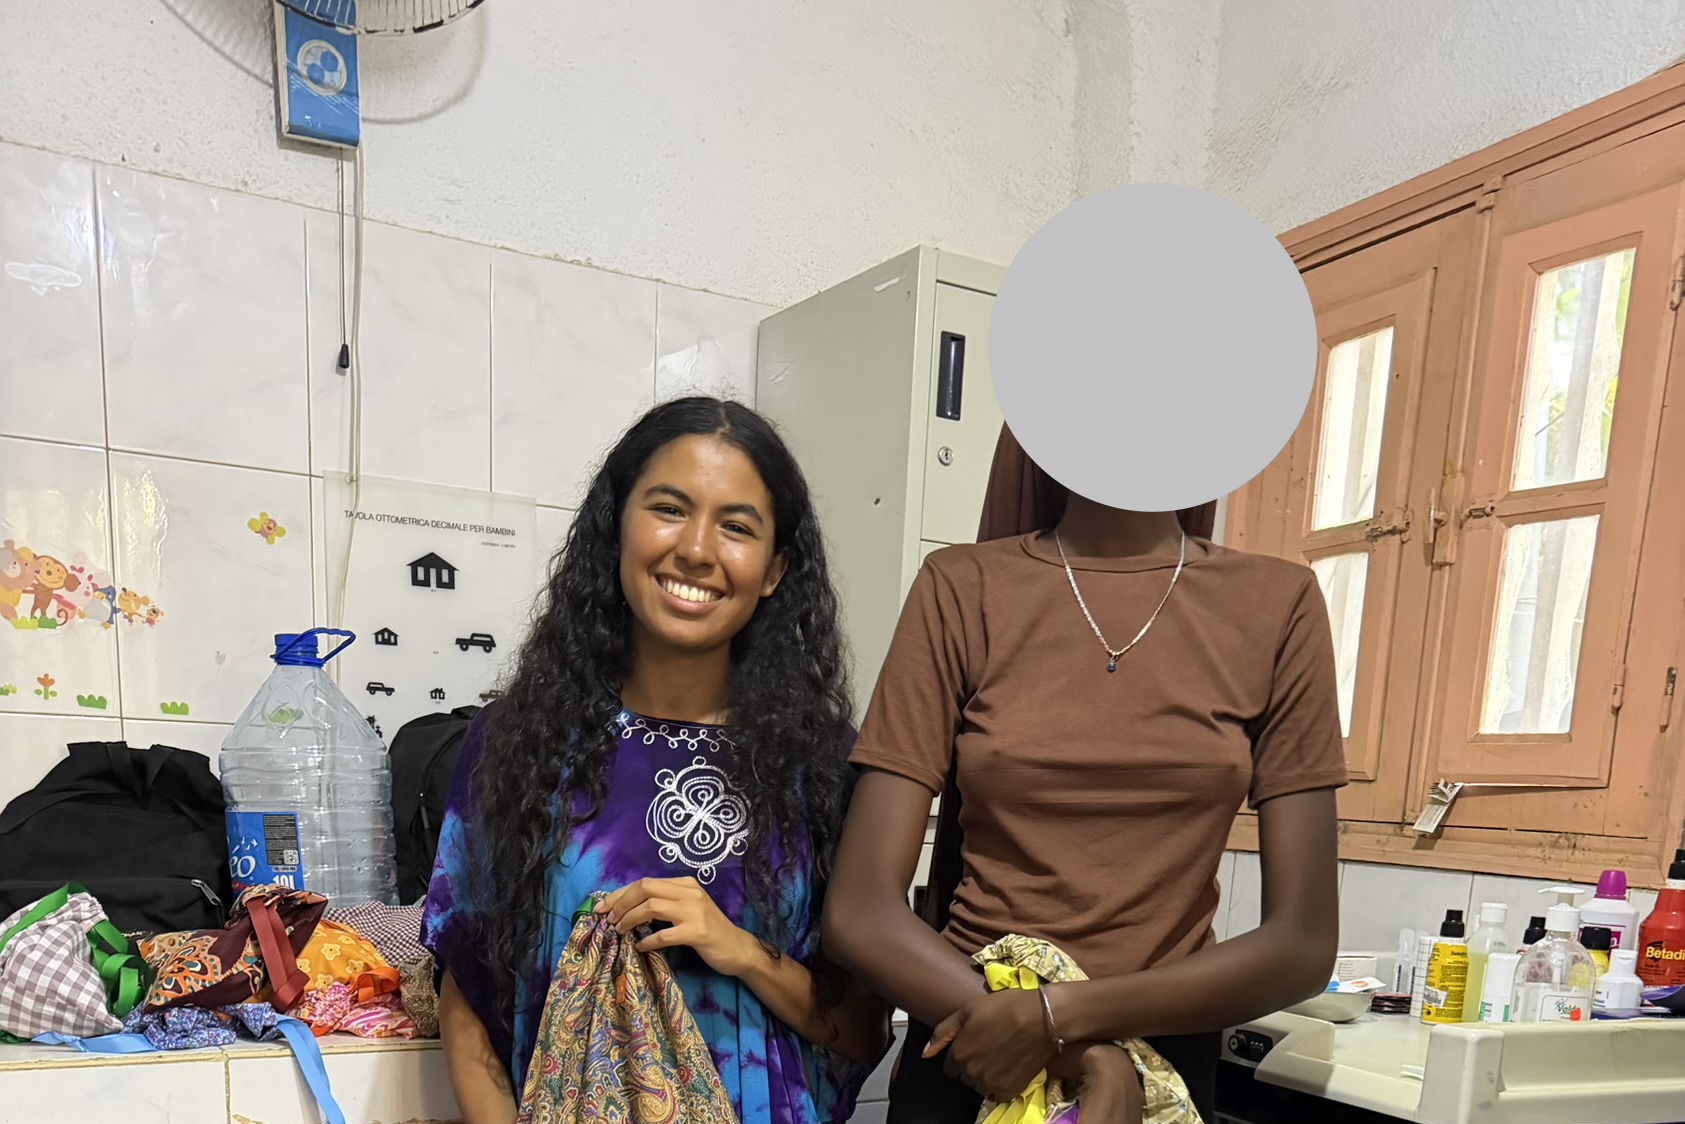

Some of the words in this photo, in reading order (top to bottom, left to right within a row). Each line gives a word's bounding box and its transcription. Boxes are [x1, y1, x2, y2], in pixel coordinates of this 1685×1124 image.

[375, 514, 430, 527] OTTOMETRICA
[431, 520, 468, 531] DECIMALE
[469, 524, 484, 533] PER
[485, 526, 516, 536] BAMBINI
